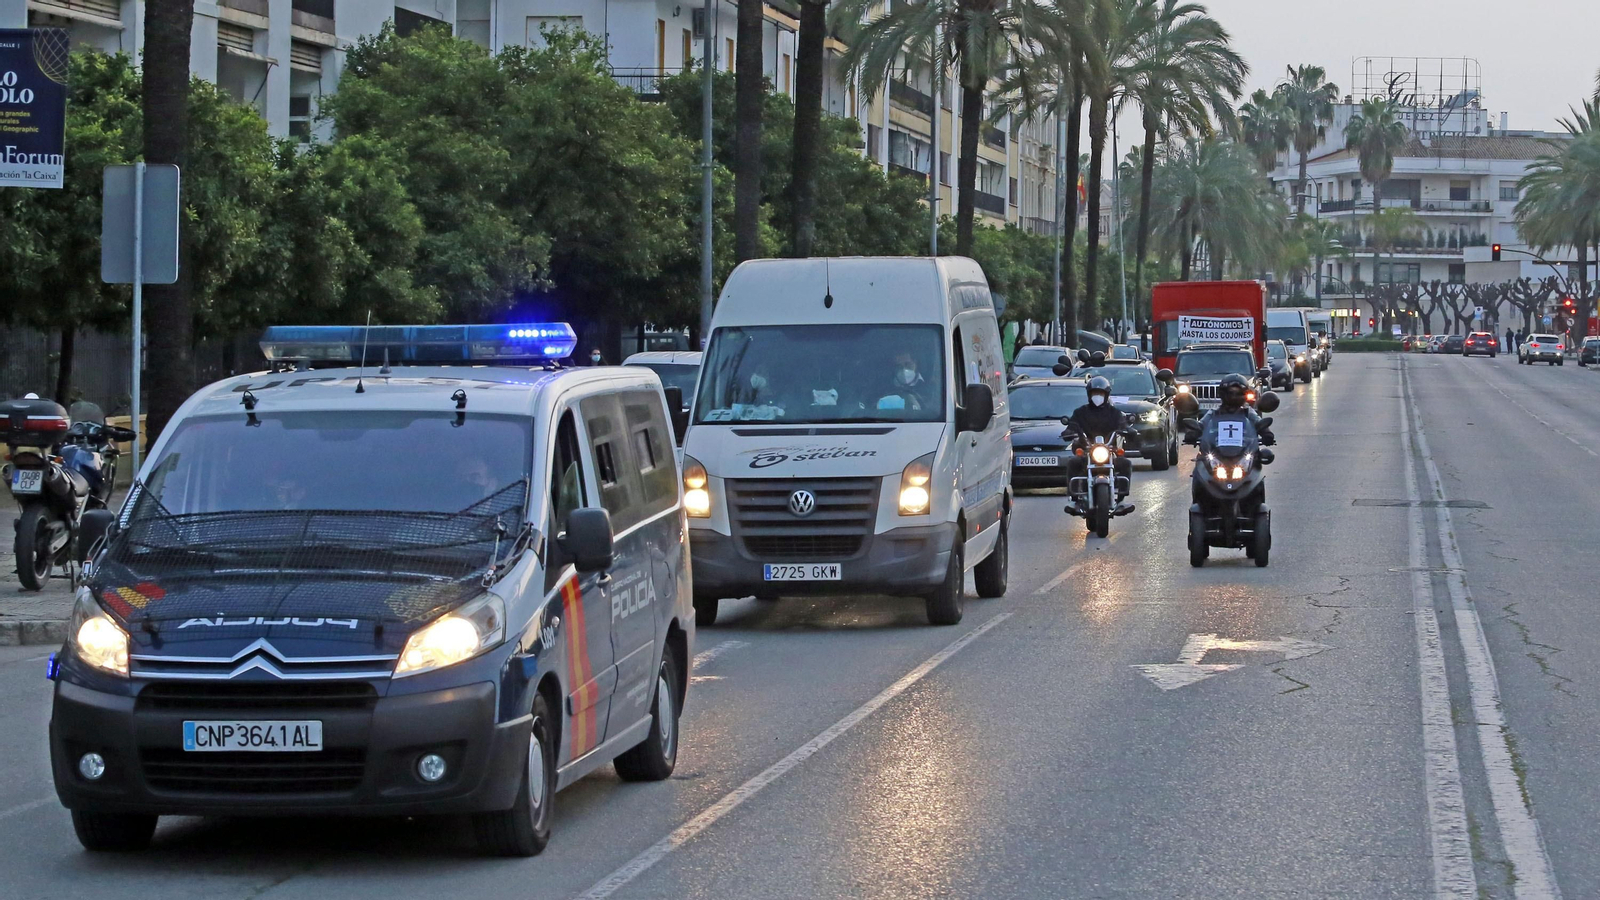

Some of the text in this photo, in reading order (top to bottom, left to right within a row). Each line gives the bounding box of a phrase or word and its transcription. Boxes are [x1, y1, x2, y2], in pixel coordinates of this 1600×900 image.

[3, 125, 39, 133] Geographic
[1191, 320, 1243, 329] AUTÓNOMOS
[1205, 331, 1219, 340] LOS
[1020, 457, 1056, 465] 2040 CKB
[20, 481, 34, 489] CLP
[772, 566, 838, 579] 2725 GKW
[611, 571, 657, 625] POLICÍA
